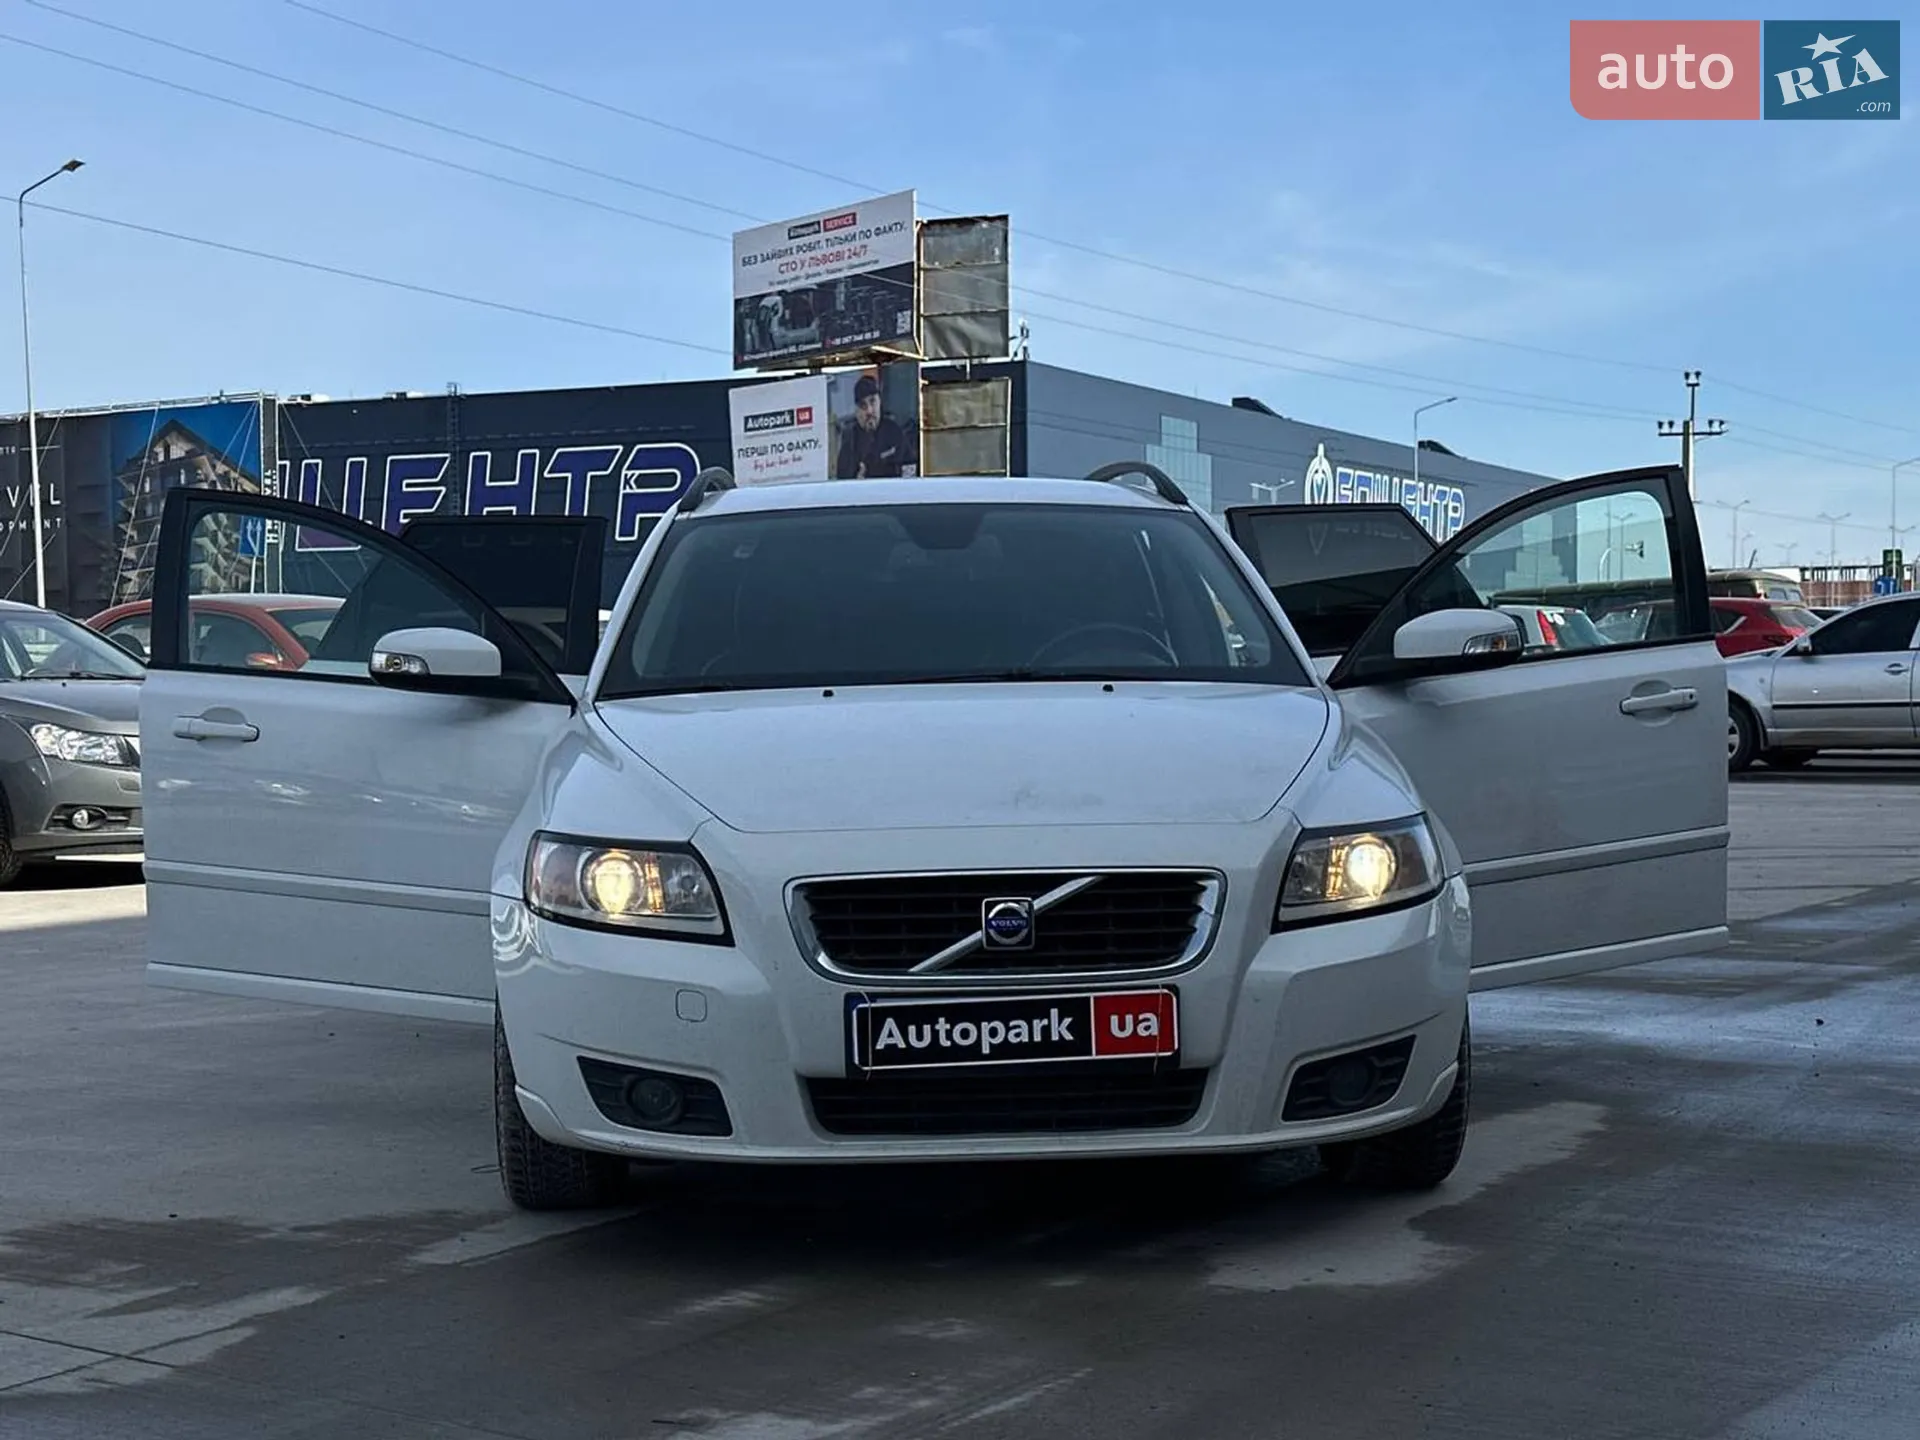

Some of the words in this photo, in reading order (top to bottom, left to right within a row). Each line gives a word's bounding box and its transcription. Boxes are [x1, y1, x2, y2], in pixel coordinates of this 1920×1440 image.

[742, 255, 758, 267] БЕЗ
[858, 229, 872, 240] ПО
[873, 221, 908, 236] ФАКТУ.
[778, 260, 797, 274] СТО
[799, 258, 807, 271] У
[846, 244, 868, 259] 24/7
[746, 411, 793, 430] Autopark
[770, 443, 785, 454] ПО
[786, 438, 823, 453] ФАКТУ.
[990, 920, 1027, 928] VOLVO
[875, 1008, 1074, 1055] Autopark
[1109, 1012, 1159, 1040] ua
